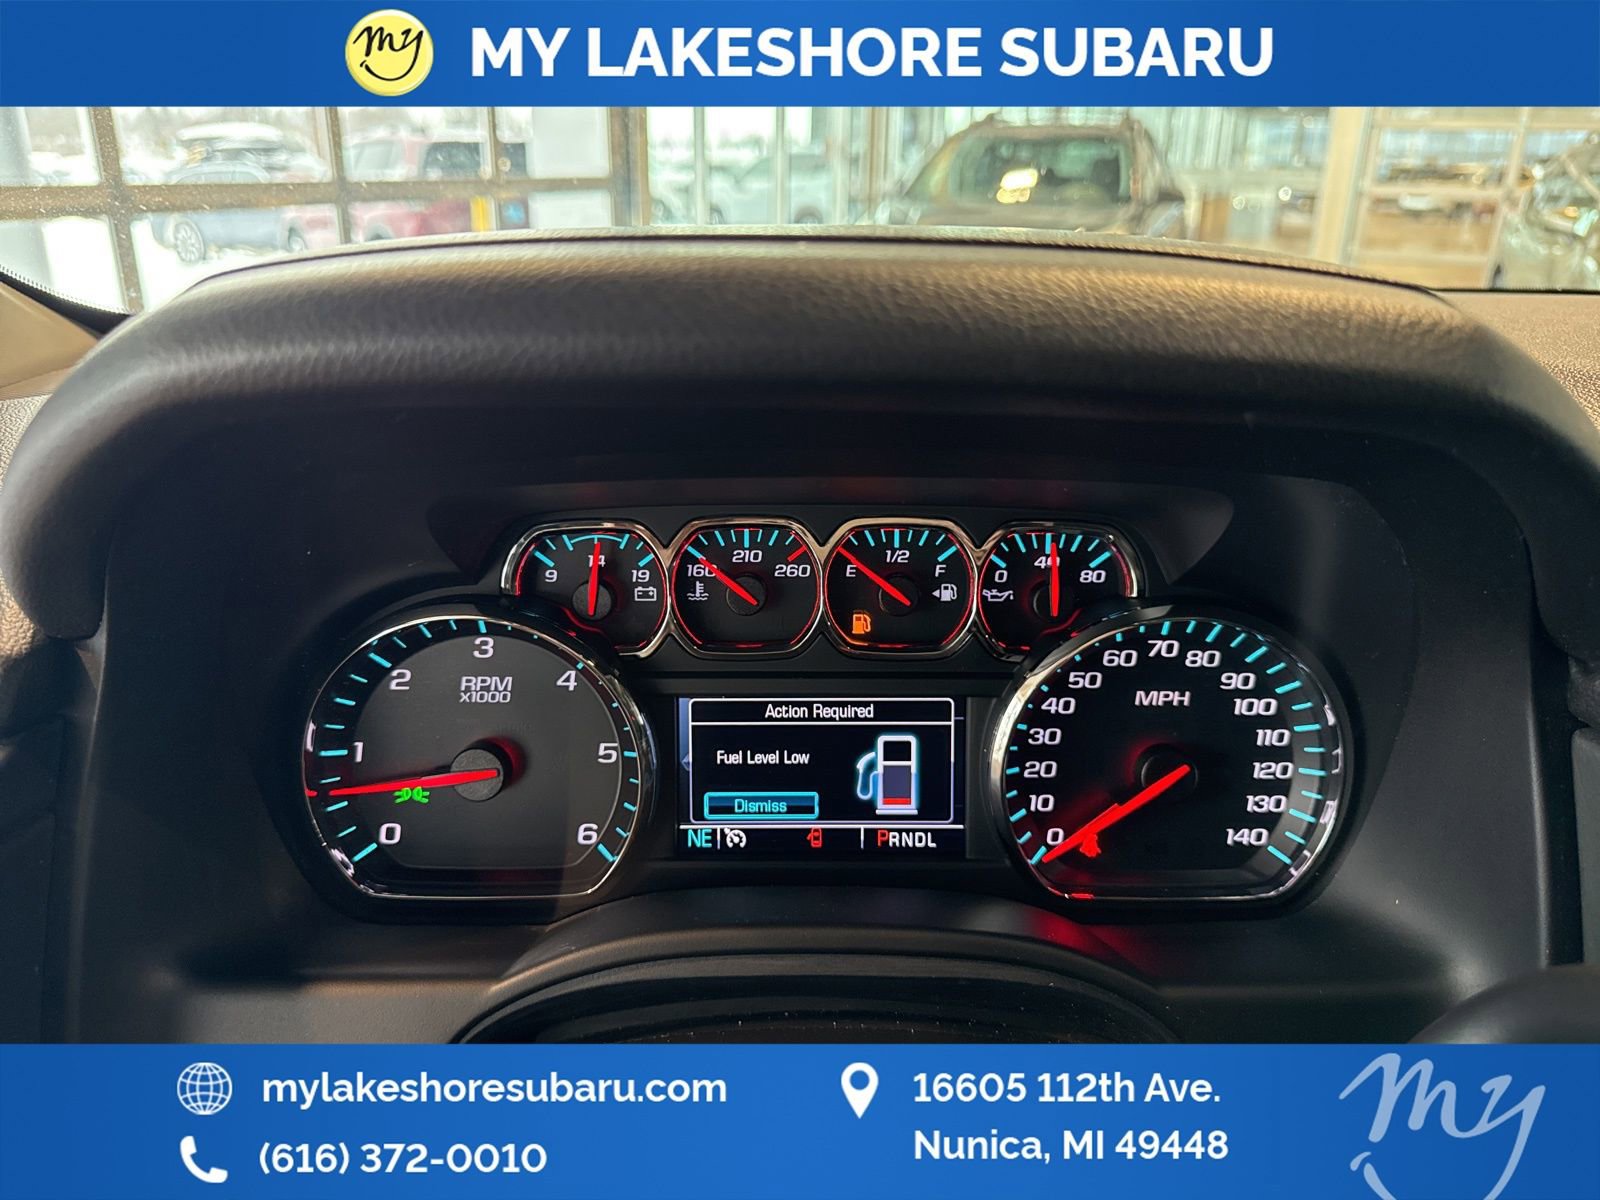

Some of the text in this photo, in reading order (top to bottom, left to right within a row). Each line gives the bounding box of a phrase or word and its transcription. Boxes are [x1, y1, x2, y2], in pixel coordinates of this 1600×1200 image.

[732, 550, 763, 564] 210
[885, 550, 910, 564] 1/2
[1033, 556, 1061, 569] 40
[544, 569, 558, 583] 9
[631, 569, 650, 583] 19
[686, 564, 717, 578] 160
[774, 564, 811, 578] 260
[845, 565, 857, 578] E
[934, 564, 947, 578] F
[994, 569, 1009, 583] 0
[1079, 569, 1107, 584] 80
[472, 637, 495, 658] 3
[1147, 640, 1180, 658] 70
[1102, 650, 1138, 667] 60
[1184, 650, 1221, 668] 80
[389, 669, 412, 691] 2
[460, 676, 513, 692] RPM
[556, 670, 578, 691] 4
[1068, 672, 1103, 689] 50
[1219, 672, 1257, 690] 90
[1040, 697, 1077, 715] 40
[1134, 690, 1191, 707] MPH
[764, 703, 875, 720] Action Required
[1233, 698, 1279, 717] 100
[1027, 728, 1062, 746] 30
[1255, 729, 1291, 747] 110
[352, 741, 364, 762] 1
[597, 742, 619, 763] 5
[716, 750, 810, 765] Fuel Level Low
[1023, 761, 1058, 778] 20
[1252, 762, 1294, 780] 120
[734, 799, 788, 813] Dismiss
[1029, 794, 1055, 812] 10
[1246, 795, 1288, 812] 130
[379, 823, 402, 845] 0
[576, 823, 600, 844] 6
[687, 828, 713, 848] NE
[877, 829, 938, 848] PRNDL
[1046, 827, 1065, 846] 0
[1225, 828, 1270, 846] 140
